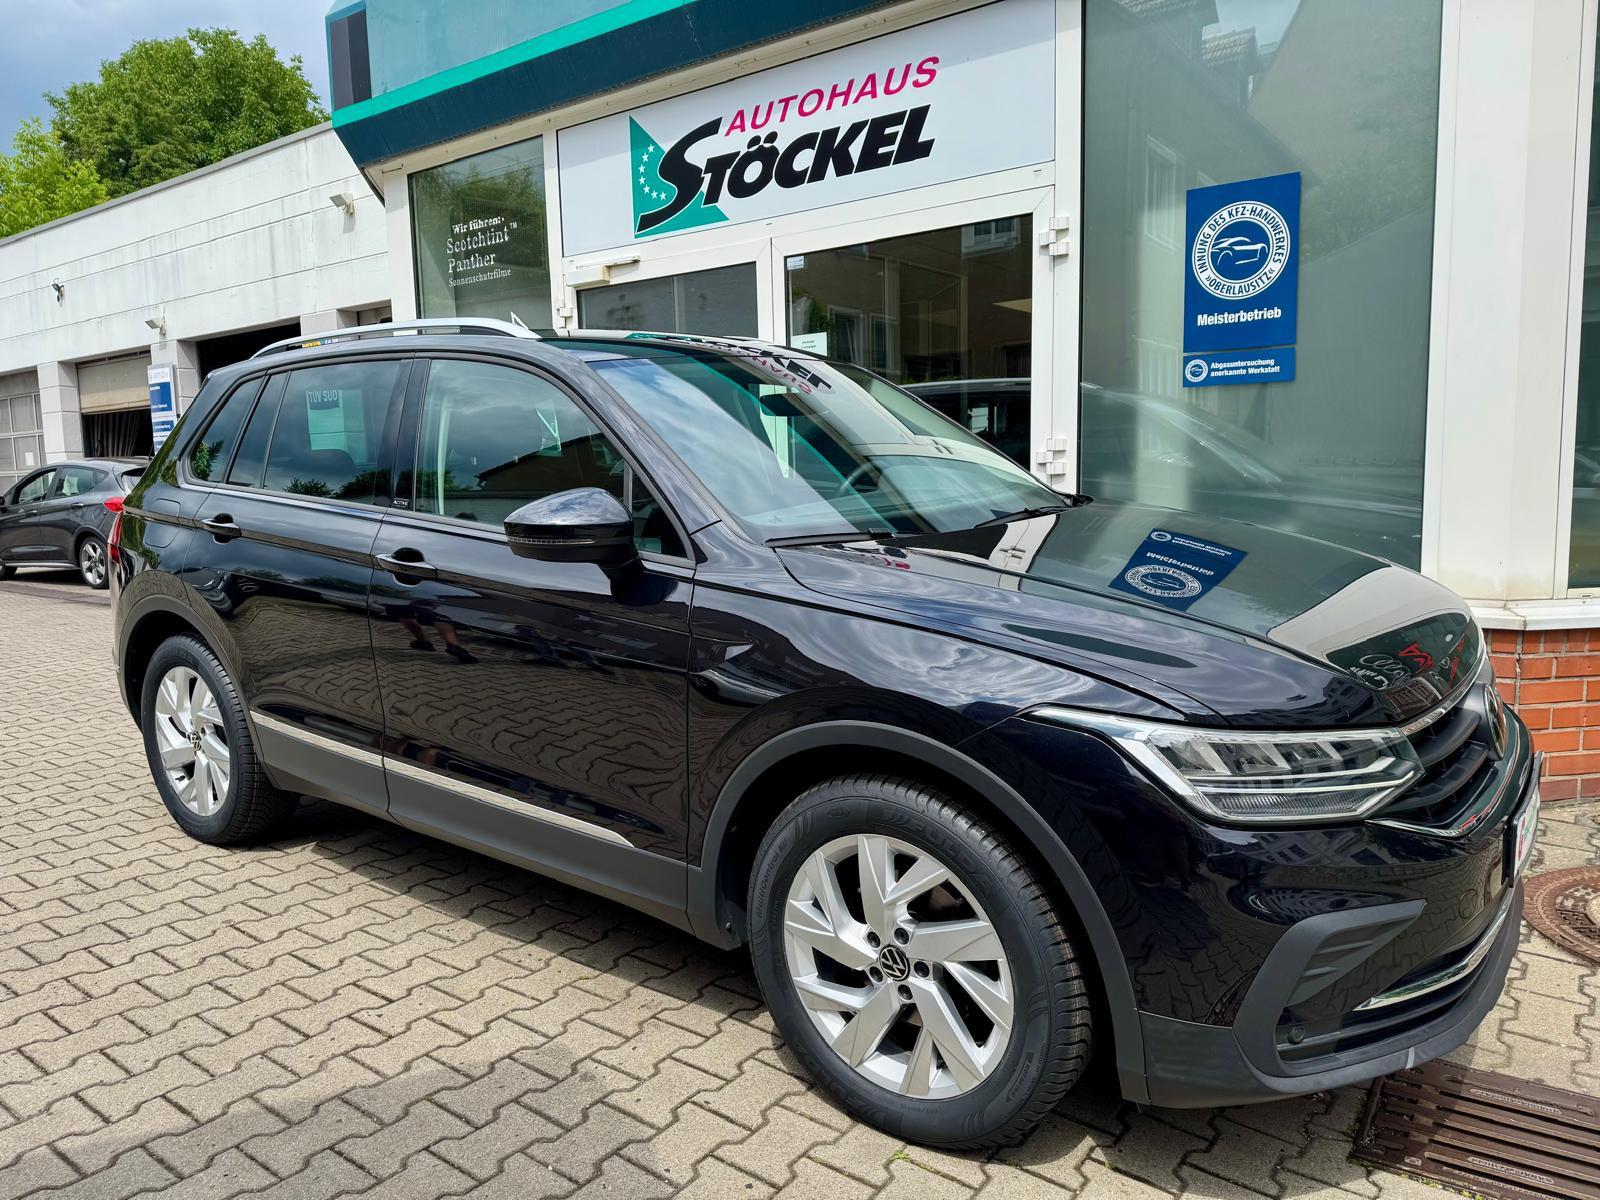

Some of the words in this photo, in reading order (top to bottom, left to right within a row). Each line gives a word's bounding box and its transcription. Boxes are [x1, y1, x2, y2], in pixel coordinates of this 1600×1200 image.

[725, 56, 940, 137] AUTOHAUS
[636, 104, 936, 233] STÖCKEL
[452, 223, 468, 234] Wir
[1196, 231, 1212, 274] INNUNG
[1208, 213, 1227, 232] DES
[1227, 205, 1286, 264] KFZ-HANDWERKES
[448, 253, 496, 273] Panther
[448, 268, 512, 288] Sonnenschutzfilme
[1197, 306, 1282, 326] Meisterbetrieb
[1210, 358, 1275, 369] Abgasuntersuchung
[1210, 367, 1247, 377] anerkannte
[1248, 365, 1280, 375] Werkstatt
